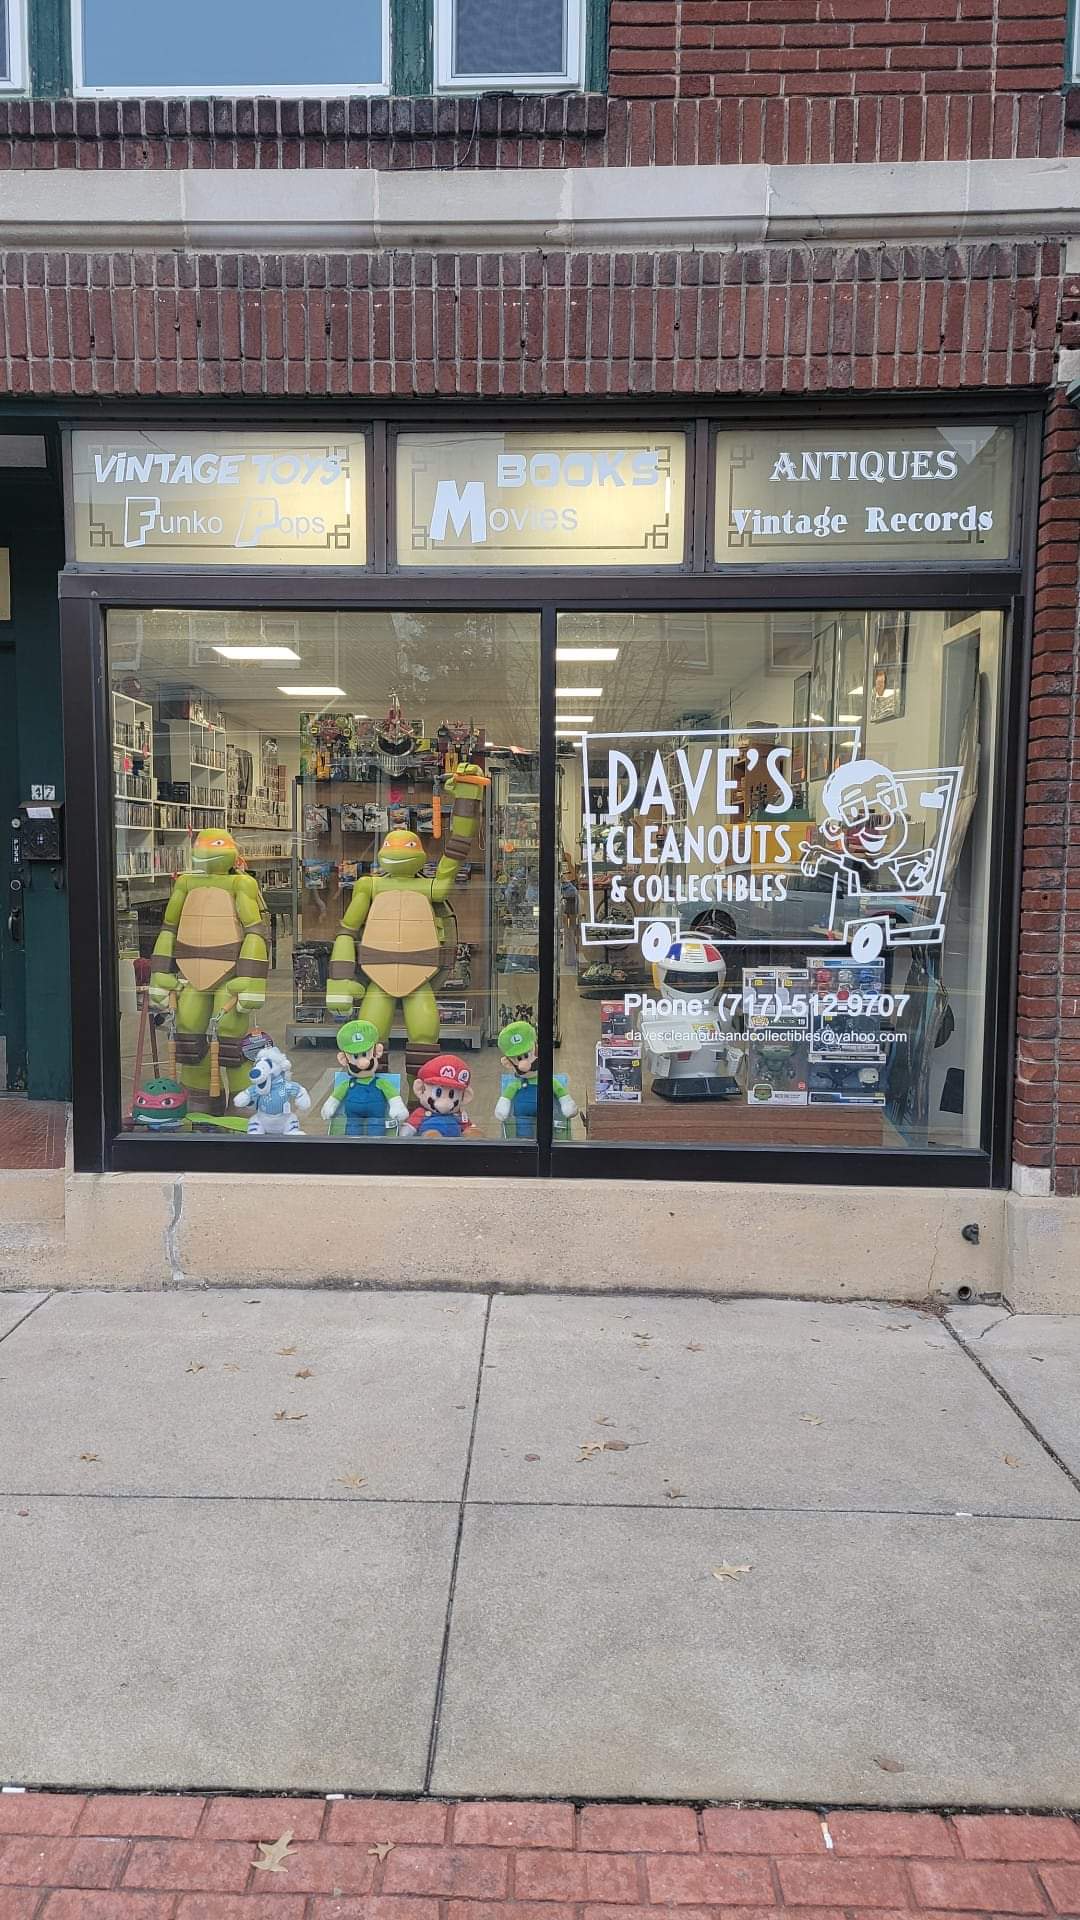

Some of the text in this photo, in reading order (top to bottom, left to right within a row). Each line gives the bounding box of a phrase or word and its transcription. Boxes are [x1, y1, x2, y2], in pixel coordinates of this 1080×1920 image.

[251, 453, 342, 485] TOYS
[497, 452, 660, 488] BOOKS
[769, 450, 959, 485] ANTIQUES
[124, 496, 325, 548] Funko Pops
[429, 479, 579, 544] Movies
[732, 504, 993, 538] Vintage Records
[609, 748, 793, 815] DAVE'S
[607, 825, 792, 865] CLEANOUTS
[610, 874, 788, 903] & COLLECTIBLES
[624, 993, 911, 1022] Phone: (717)-512-9707
[626, 1029, 908, 1046] davescleanoutsandcollectibles@yahoo.com
